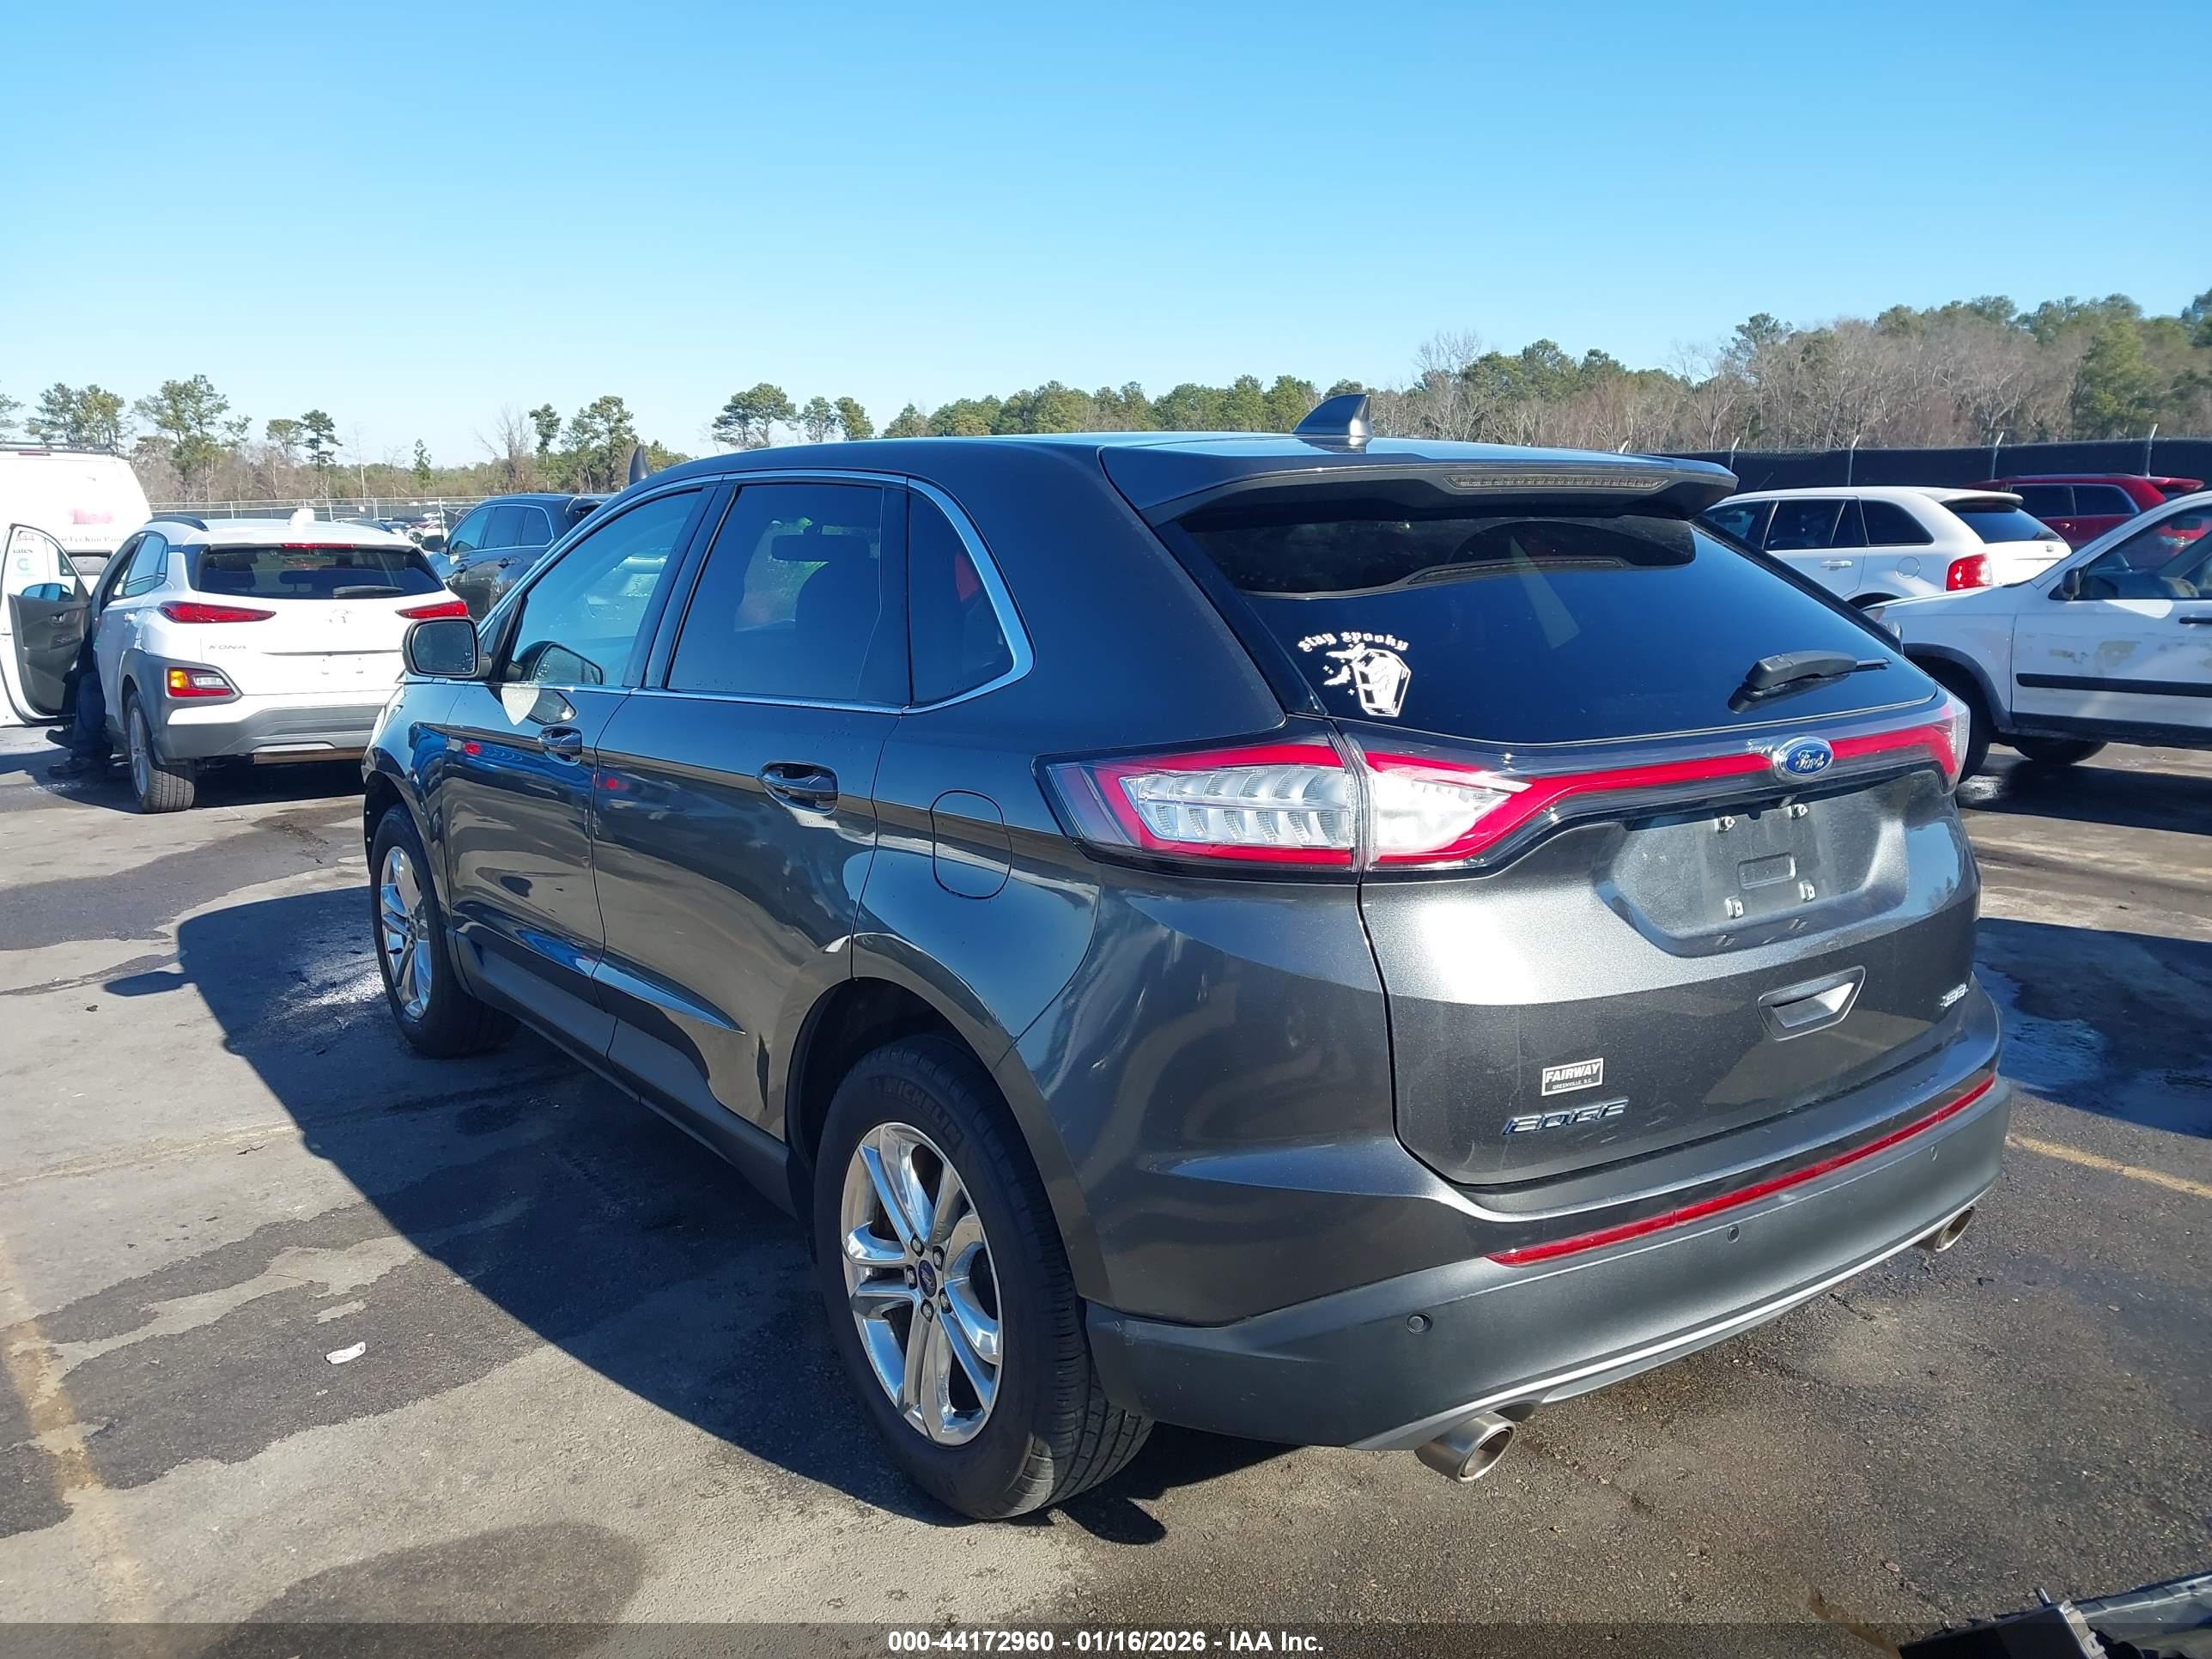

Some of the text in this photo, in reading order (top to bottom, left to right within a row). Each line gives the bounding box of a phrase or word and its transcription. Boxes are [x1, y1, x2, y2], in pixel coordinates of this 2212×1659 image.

[1795, 749, 1825, 772] Ford
[1546, 1062, 1601, 1083] FAIRWAY
[882, 1077, 963, 1146] MICHELIN
[1503, 1097, 1630, 1135] EDGE
